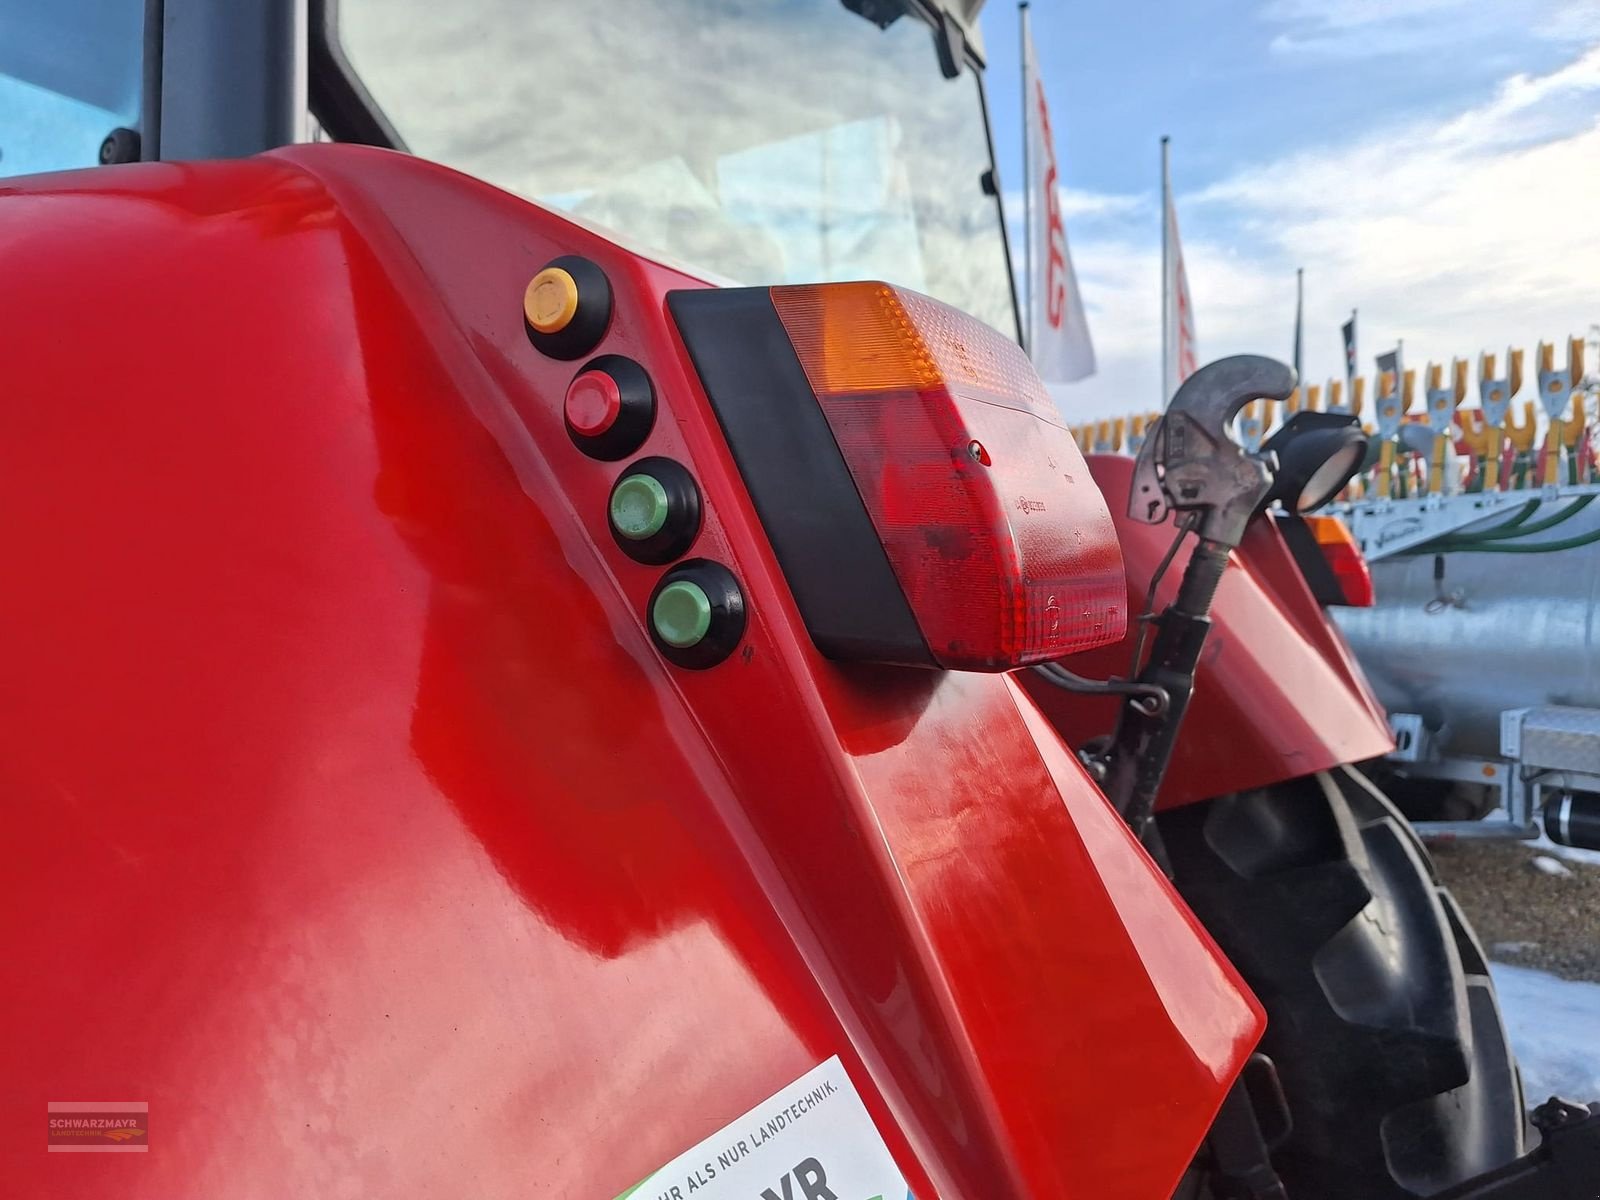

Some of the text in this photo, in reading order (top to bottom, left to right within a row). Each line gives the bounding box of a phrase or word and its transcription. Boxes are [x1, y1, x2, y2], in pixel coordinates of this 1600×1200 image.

[686, 1162, 716, 1194] ALS
[717, 1140, 750, 1171] NUR
[750, 1080, 838, 1148] LANDTECHNIK.
